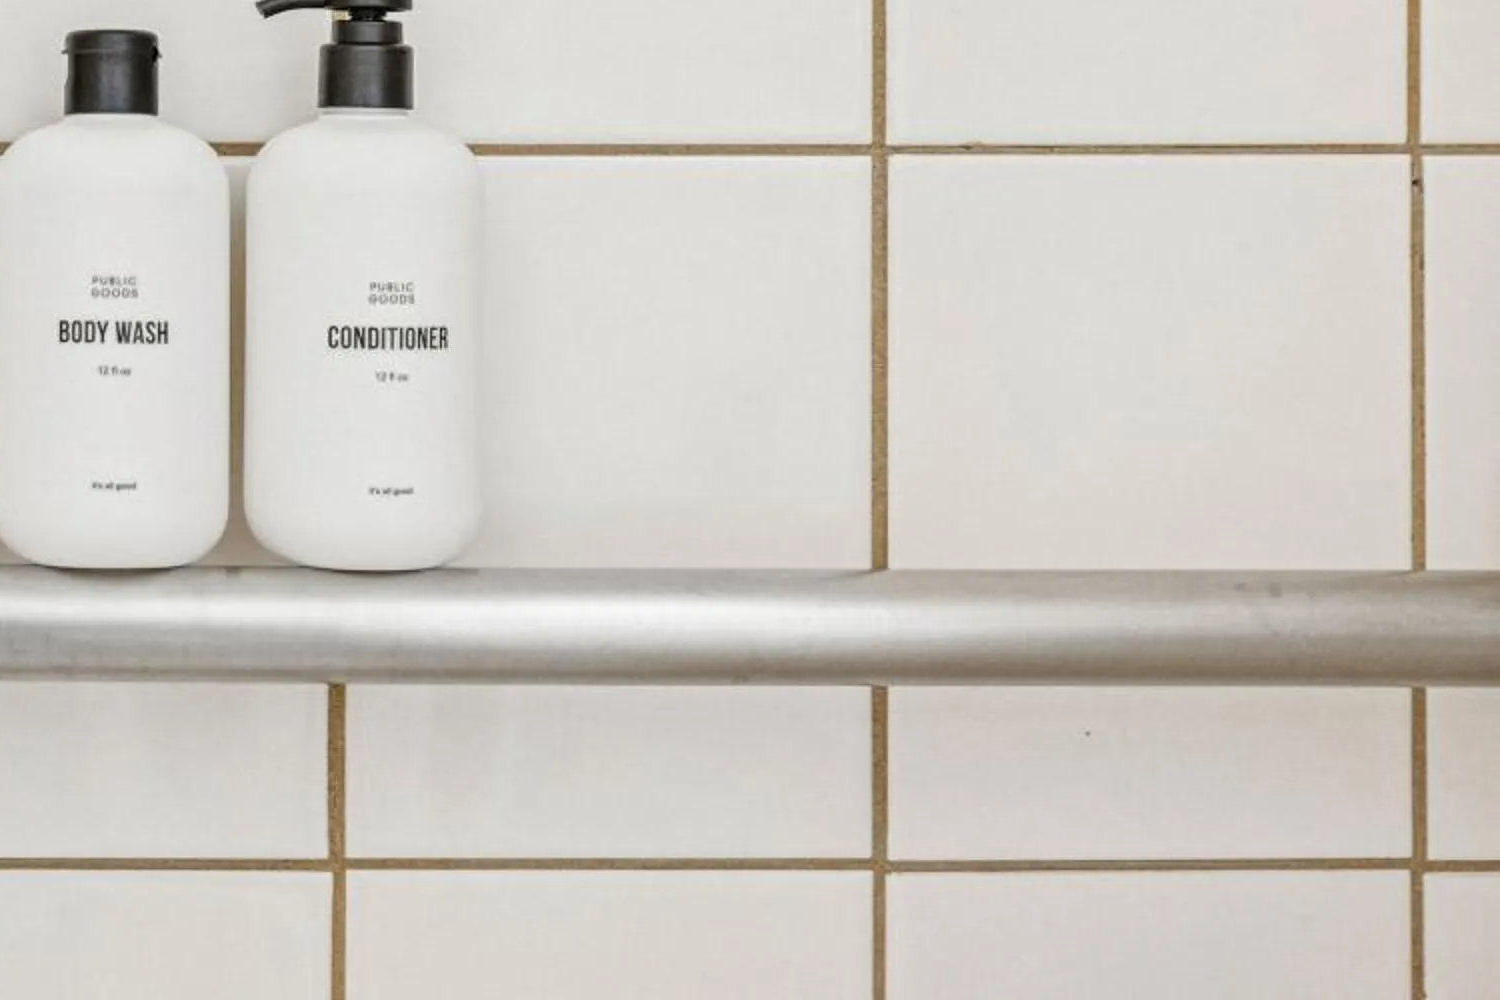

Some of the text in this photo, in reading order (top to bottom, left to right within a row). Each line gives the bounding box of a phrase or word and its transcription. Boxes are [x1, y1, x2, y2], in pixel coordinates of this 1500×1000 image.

[91, 275, 137, 286] PUBLIC
[368, 281, 414, 292] PUBLIC
[90, 287, 139, 299] GOODS
[367, 293, 416, 306] GOODS
[58, 319, 170, 345] BODY WASH
[326, 324, 450, 351] CONDITIONER
